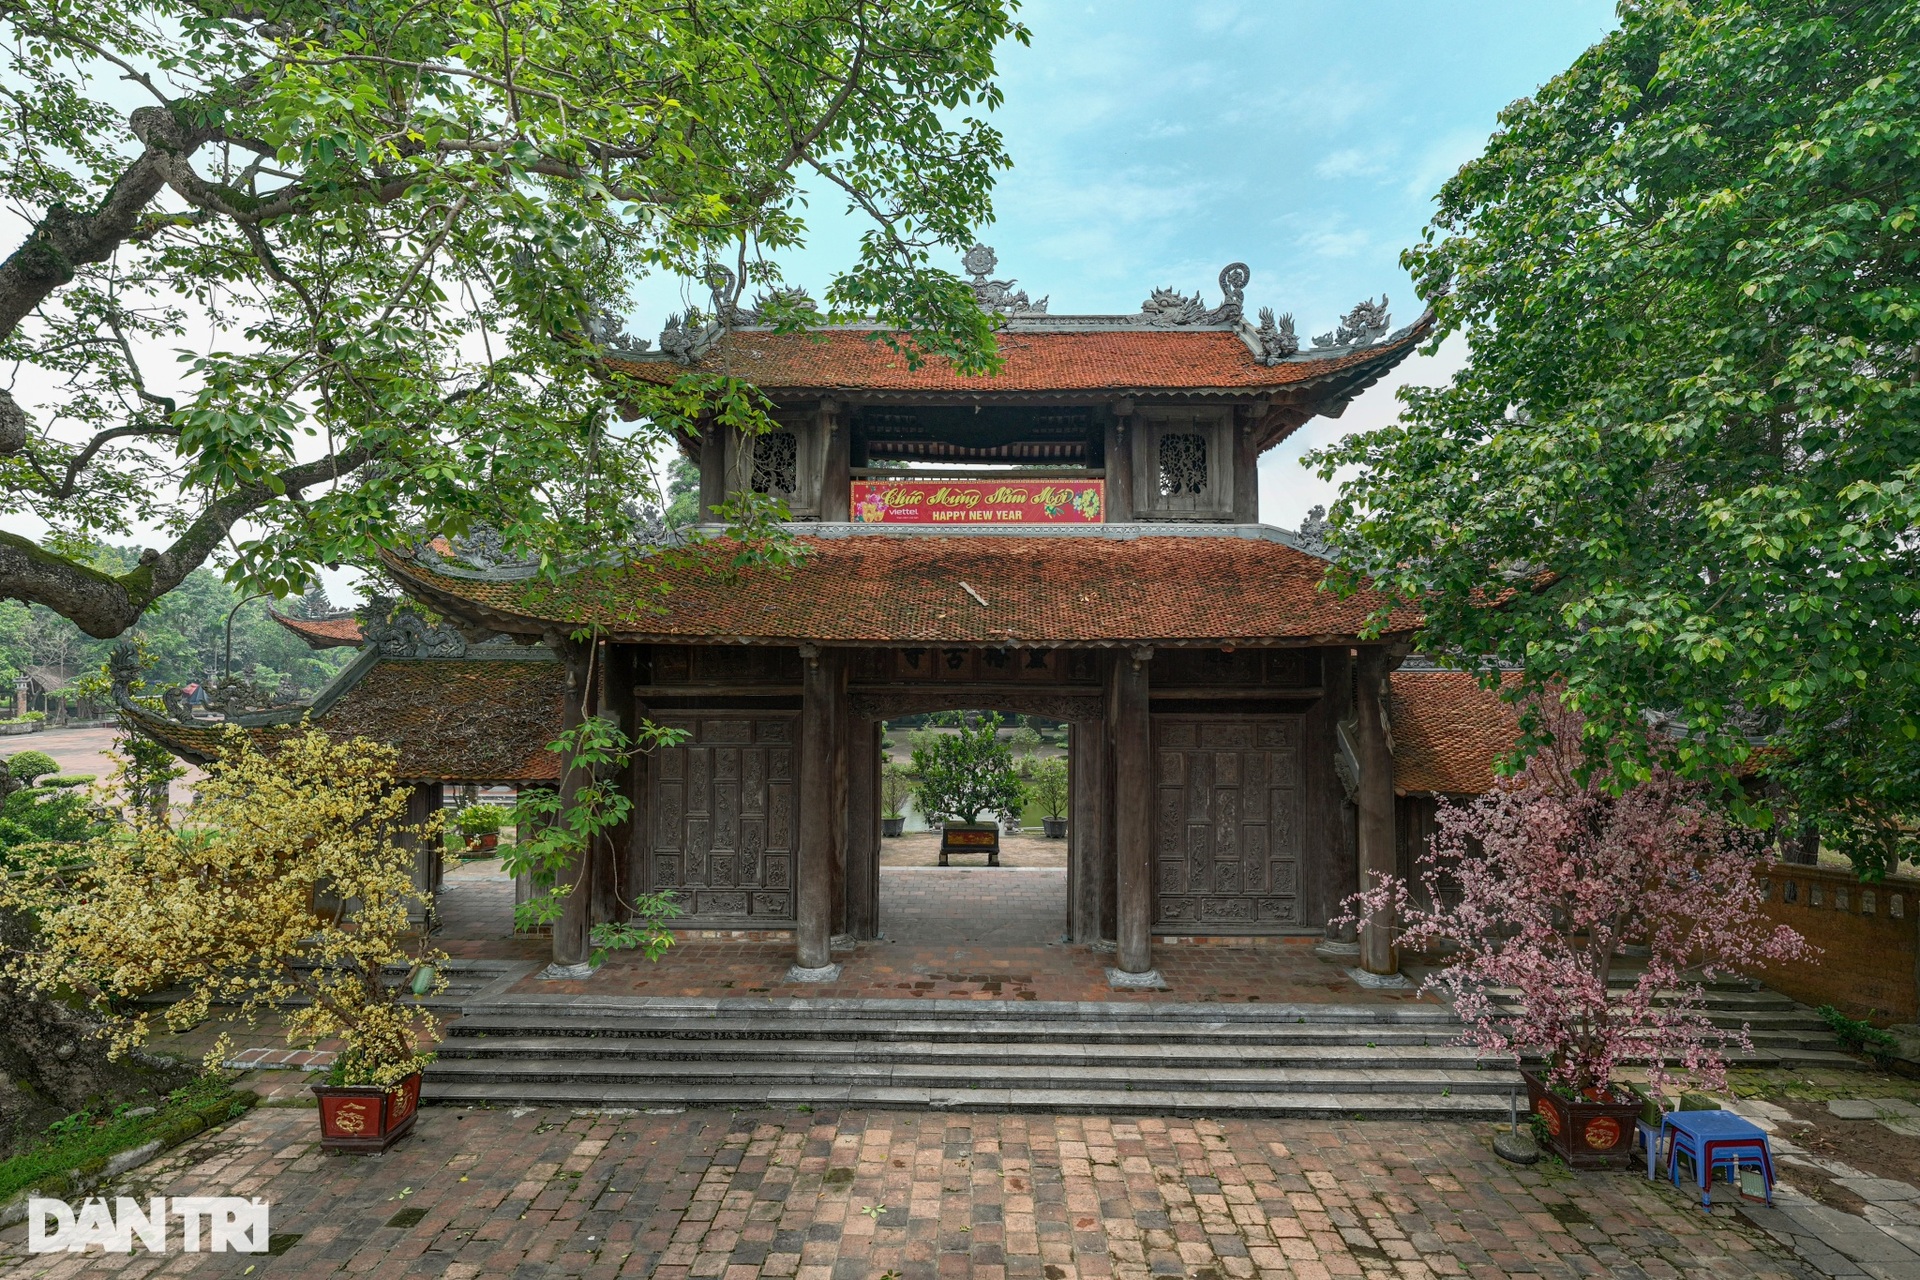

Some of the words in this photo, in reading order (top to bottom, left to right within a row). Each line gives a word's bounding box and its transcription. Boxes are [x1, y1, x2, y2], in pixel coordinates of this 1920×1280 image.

[926, 486, 982, 509] Mừng
[984, 486, 1028, 504] Năm
[1030, 486, 1074, 507] Mới
[932, 511, 966, 521] HAPPY
[969, 510, 993, 520] NEW
[996, 510, 1023, 520] YEAR
